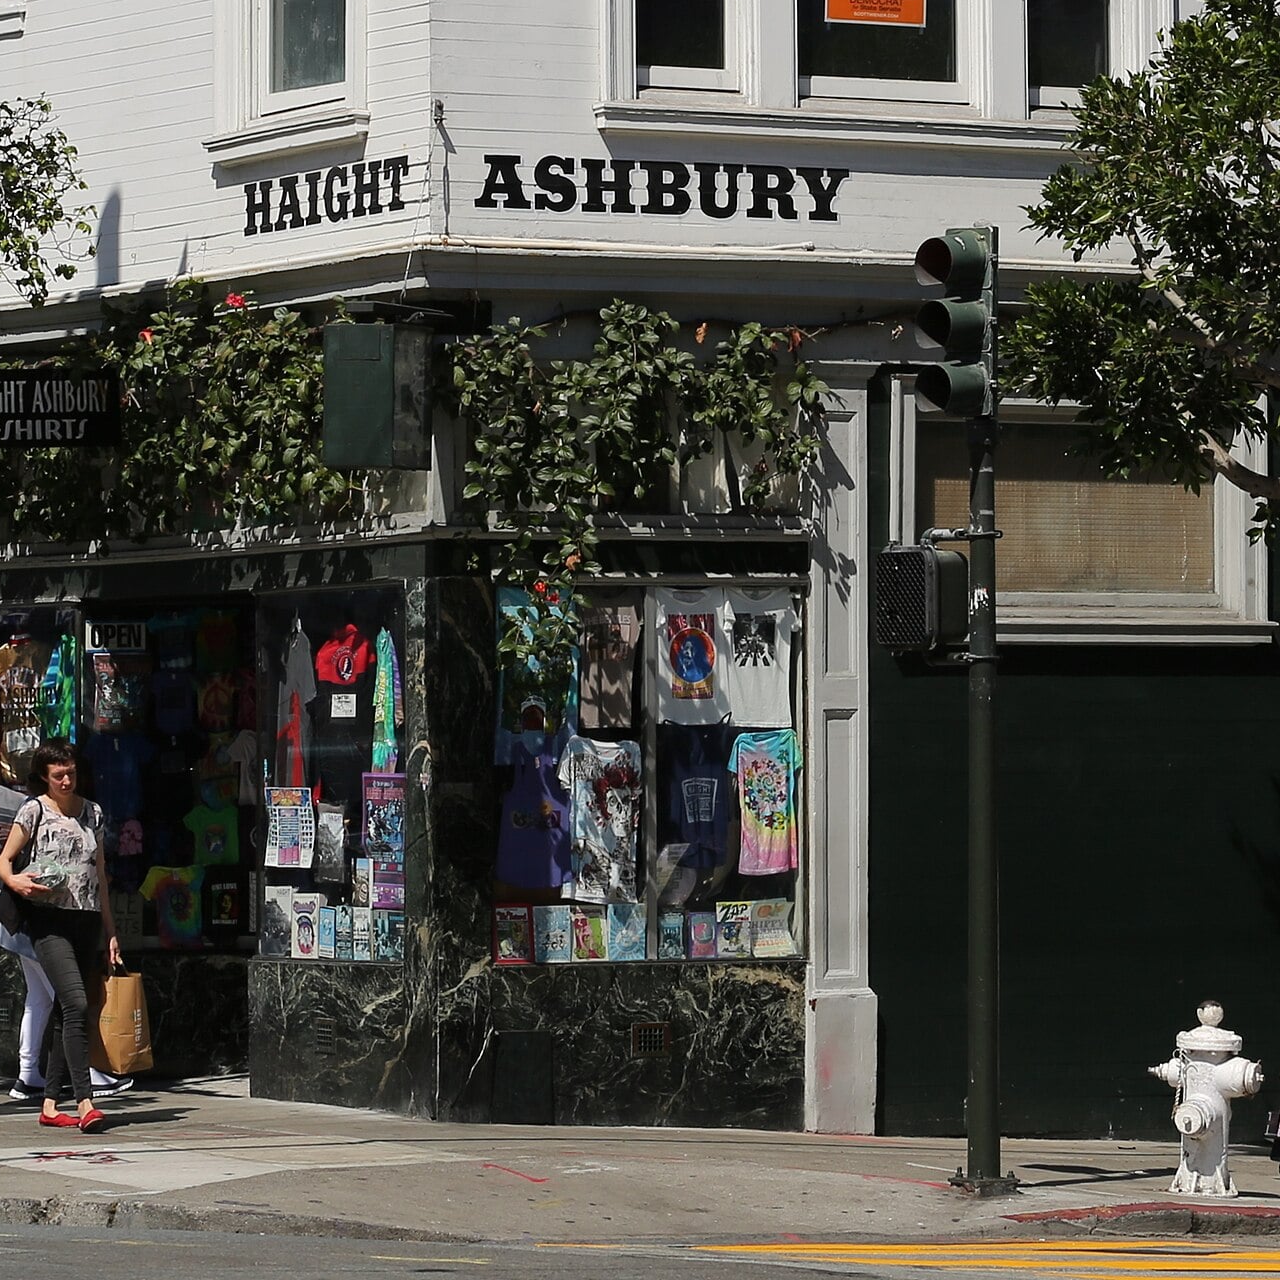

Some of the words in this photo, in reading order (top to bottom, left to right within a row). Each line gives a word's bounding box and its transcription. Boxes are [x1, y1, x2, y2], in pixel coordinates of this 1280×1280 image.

[243, 156, 412, 237] HAIGHT
[473, 153, 851, 222] ASHBURY
[31, 379, 110, 414] ASHBURY
[91, 623, 141, 648] OPEN
[720, 903, 748, 921] ZAP
